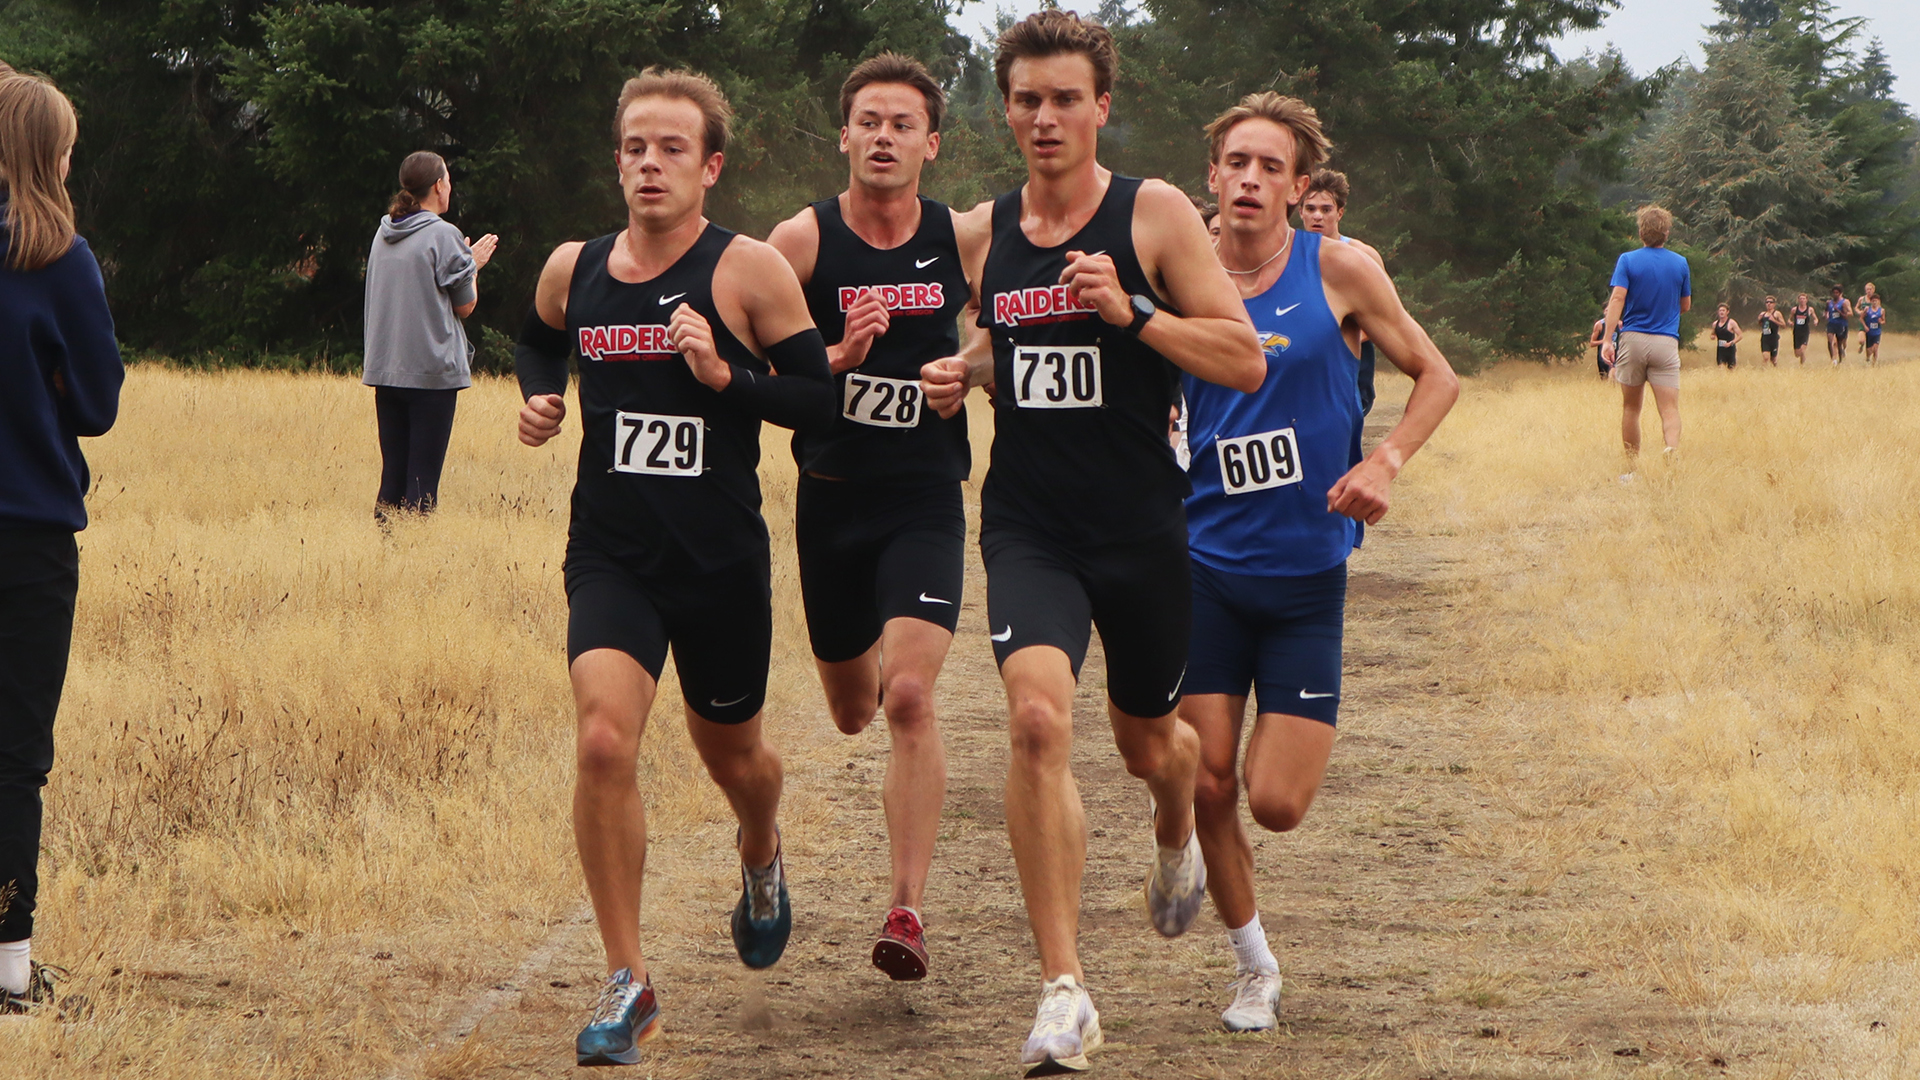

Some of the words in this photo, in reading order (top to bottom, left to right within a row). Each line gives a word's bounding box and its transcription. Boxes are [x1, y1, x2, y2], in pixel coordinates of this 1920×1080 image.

[839, 282, 945, 313] RDERS
[848, 379, 918, 423] 728
[1020, 352, 1095, 402] 730
[621, 418, 697, 470] 729
[1223, 435, 1295, 488] 609
